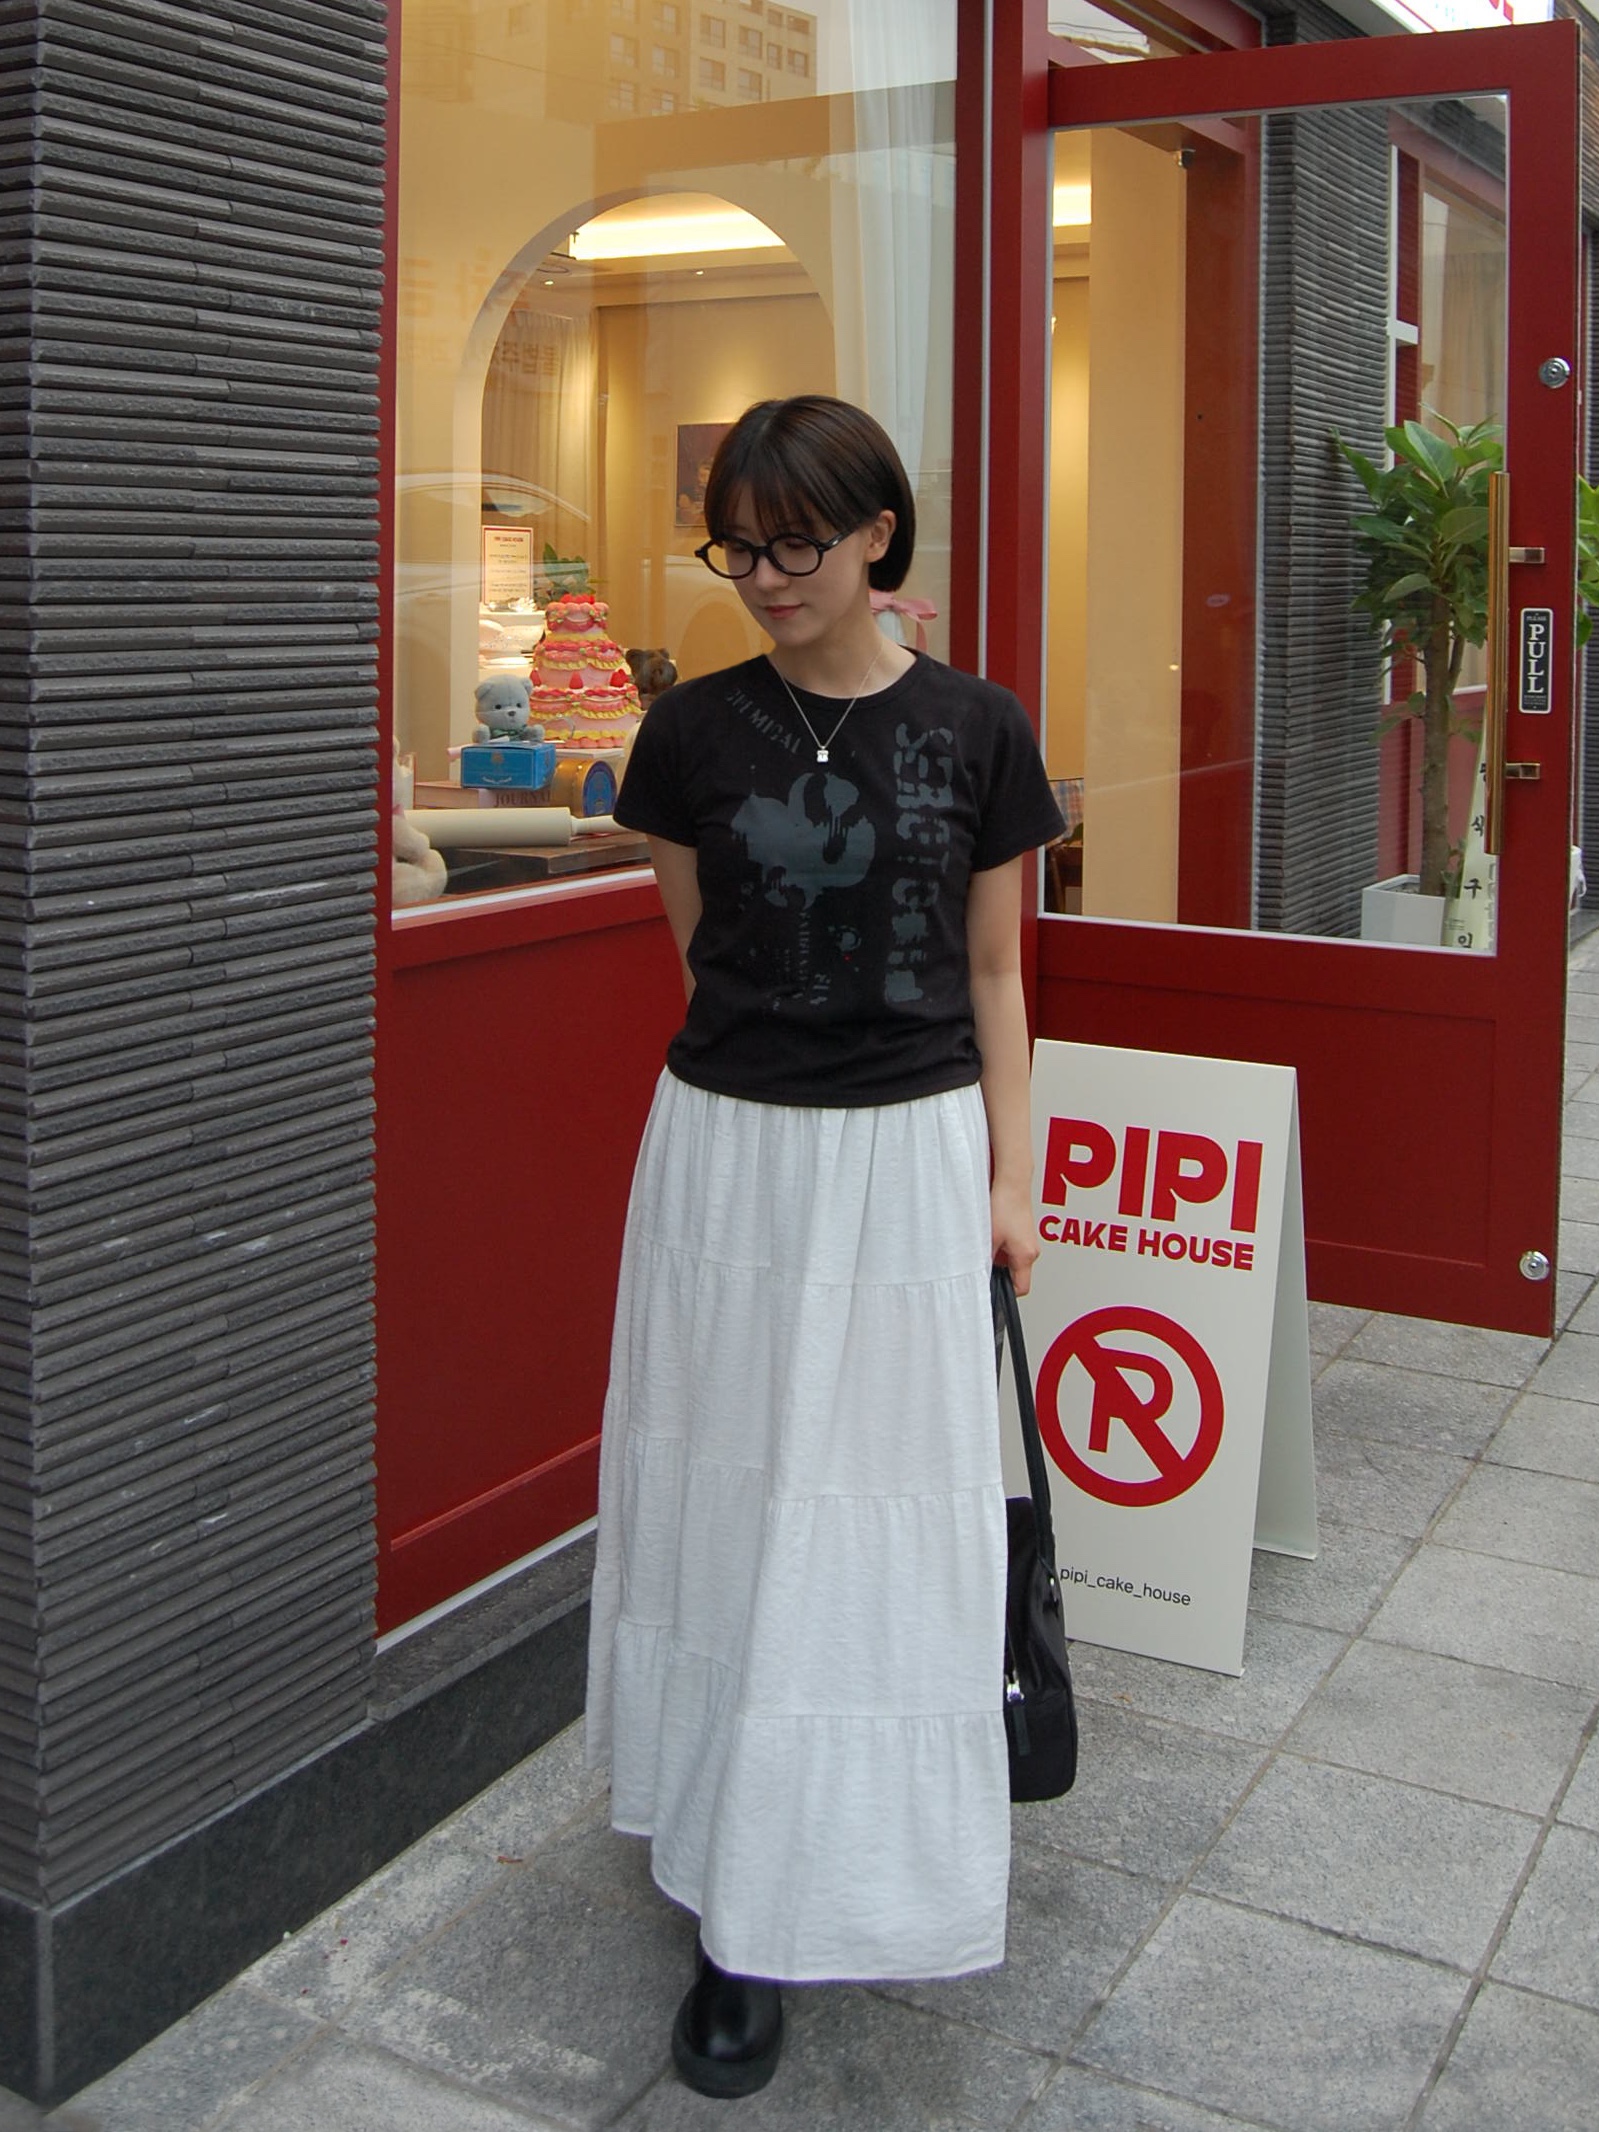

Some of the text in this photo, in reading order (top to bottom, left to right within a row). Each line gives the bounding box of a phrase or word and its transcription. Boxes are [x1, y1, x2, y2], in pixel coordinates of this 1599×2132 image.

[1527, 623, 1546, 693] PULL
[1041, 1116, 1264, 1234] PIPI
[1038, 1214, 1255, 1272] CAKE HOUSE
[1059, 1566, 1192, 1606] pipi_cake_house
